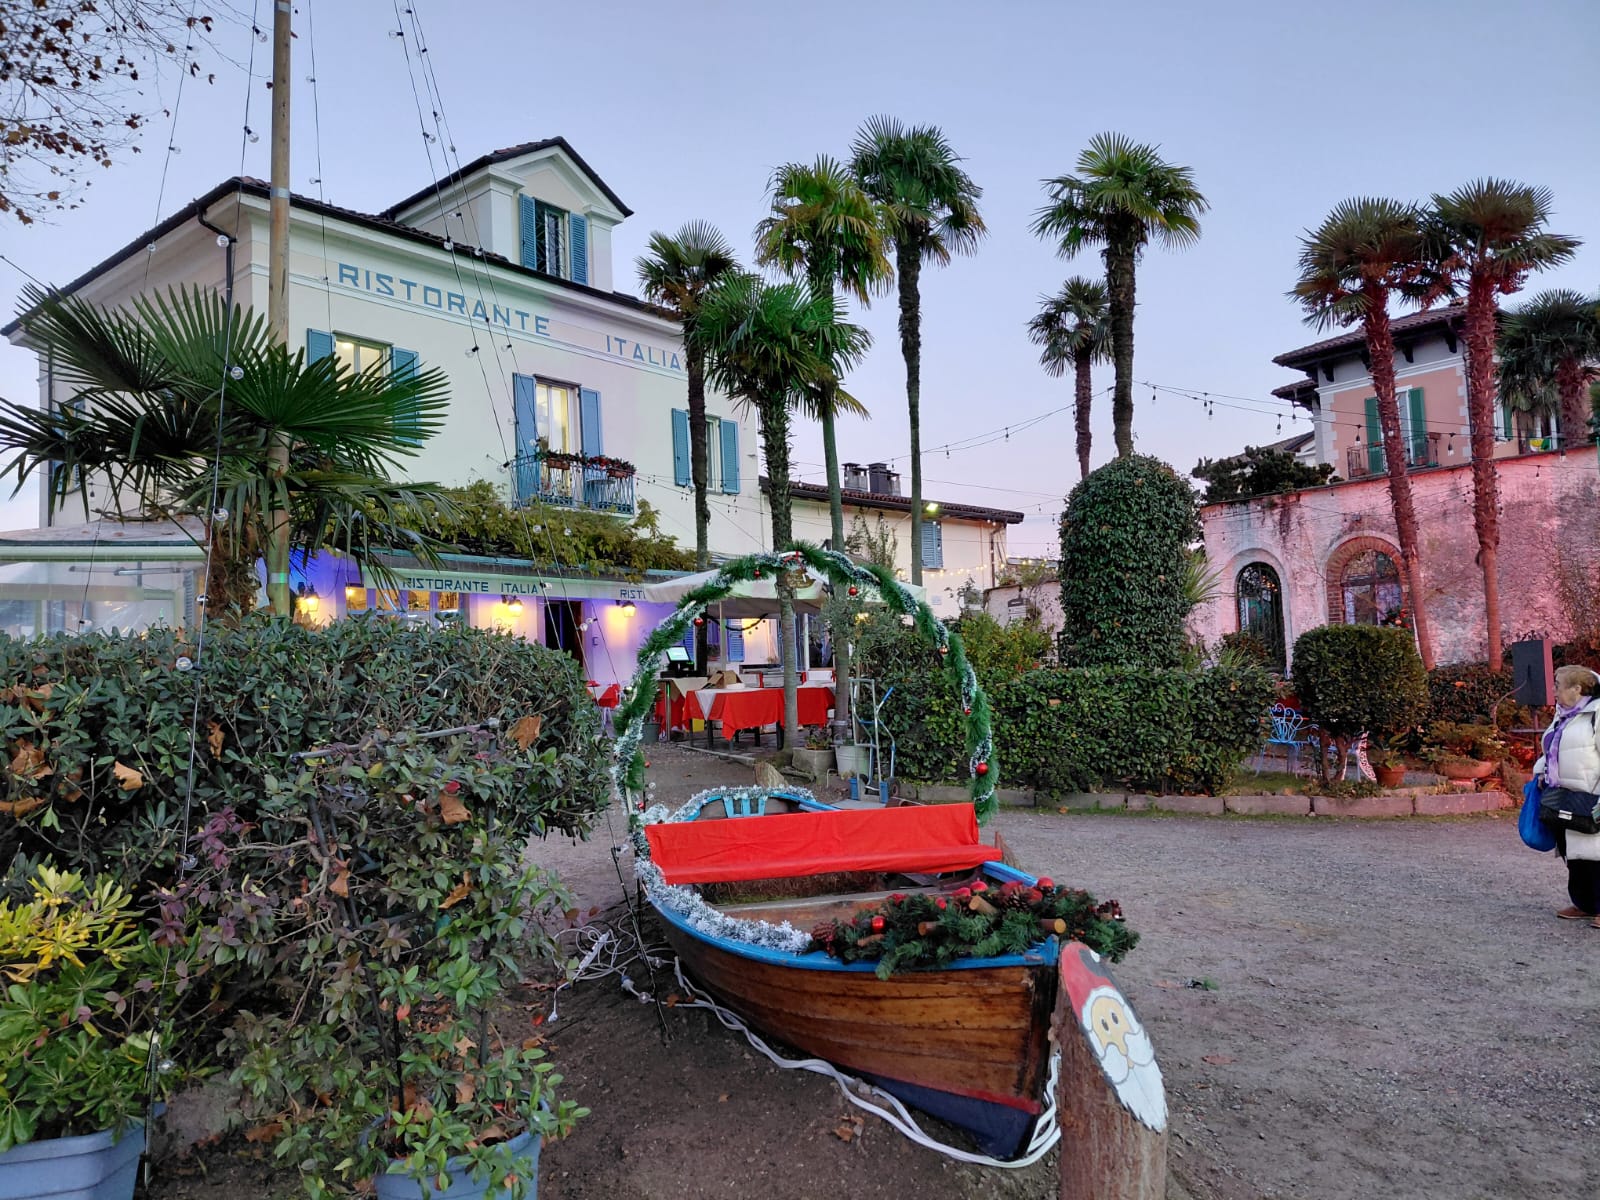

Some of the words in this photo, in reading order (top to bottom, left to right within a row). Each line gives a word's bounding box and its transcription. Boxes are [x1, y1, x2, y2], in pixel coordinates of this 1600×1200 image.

[338, 262, 551, 336] RISTORANTE
[606, 334, 682, 371] ITALIA
[402, 577, 489, 592] RISTORANTE
[500, 582, 539, 594] ITALIA
